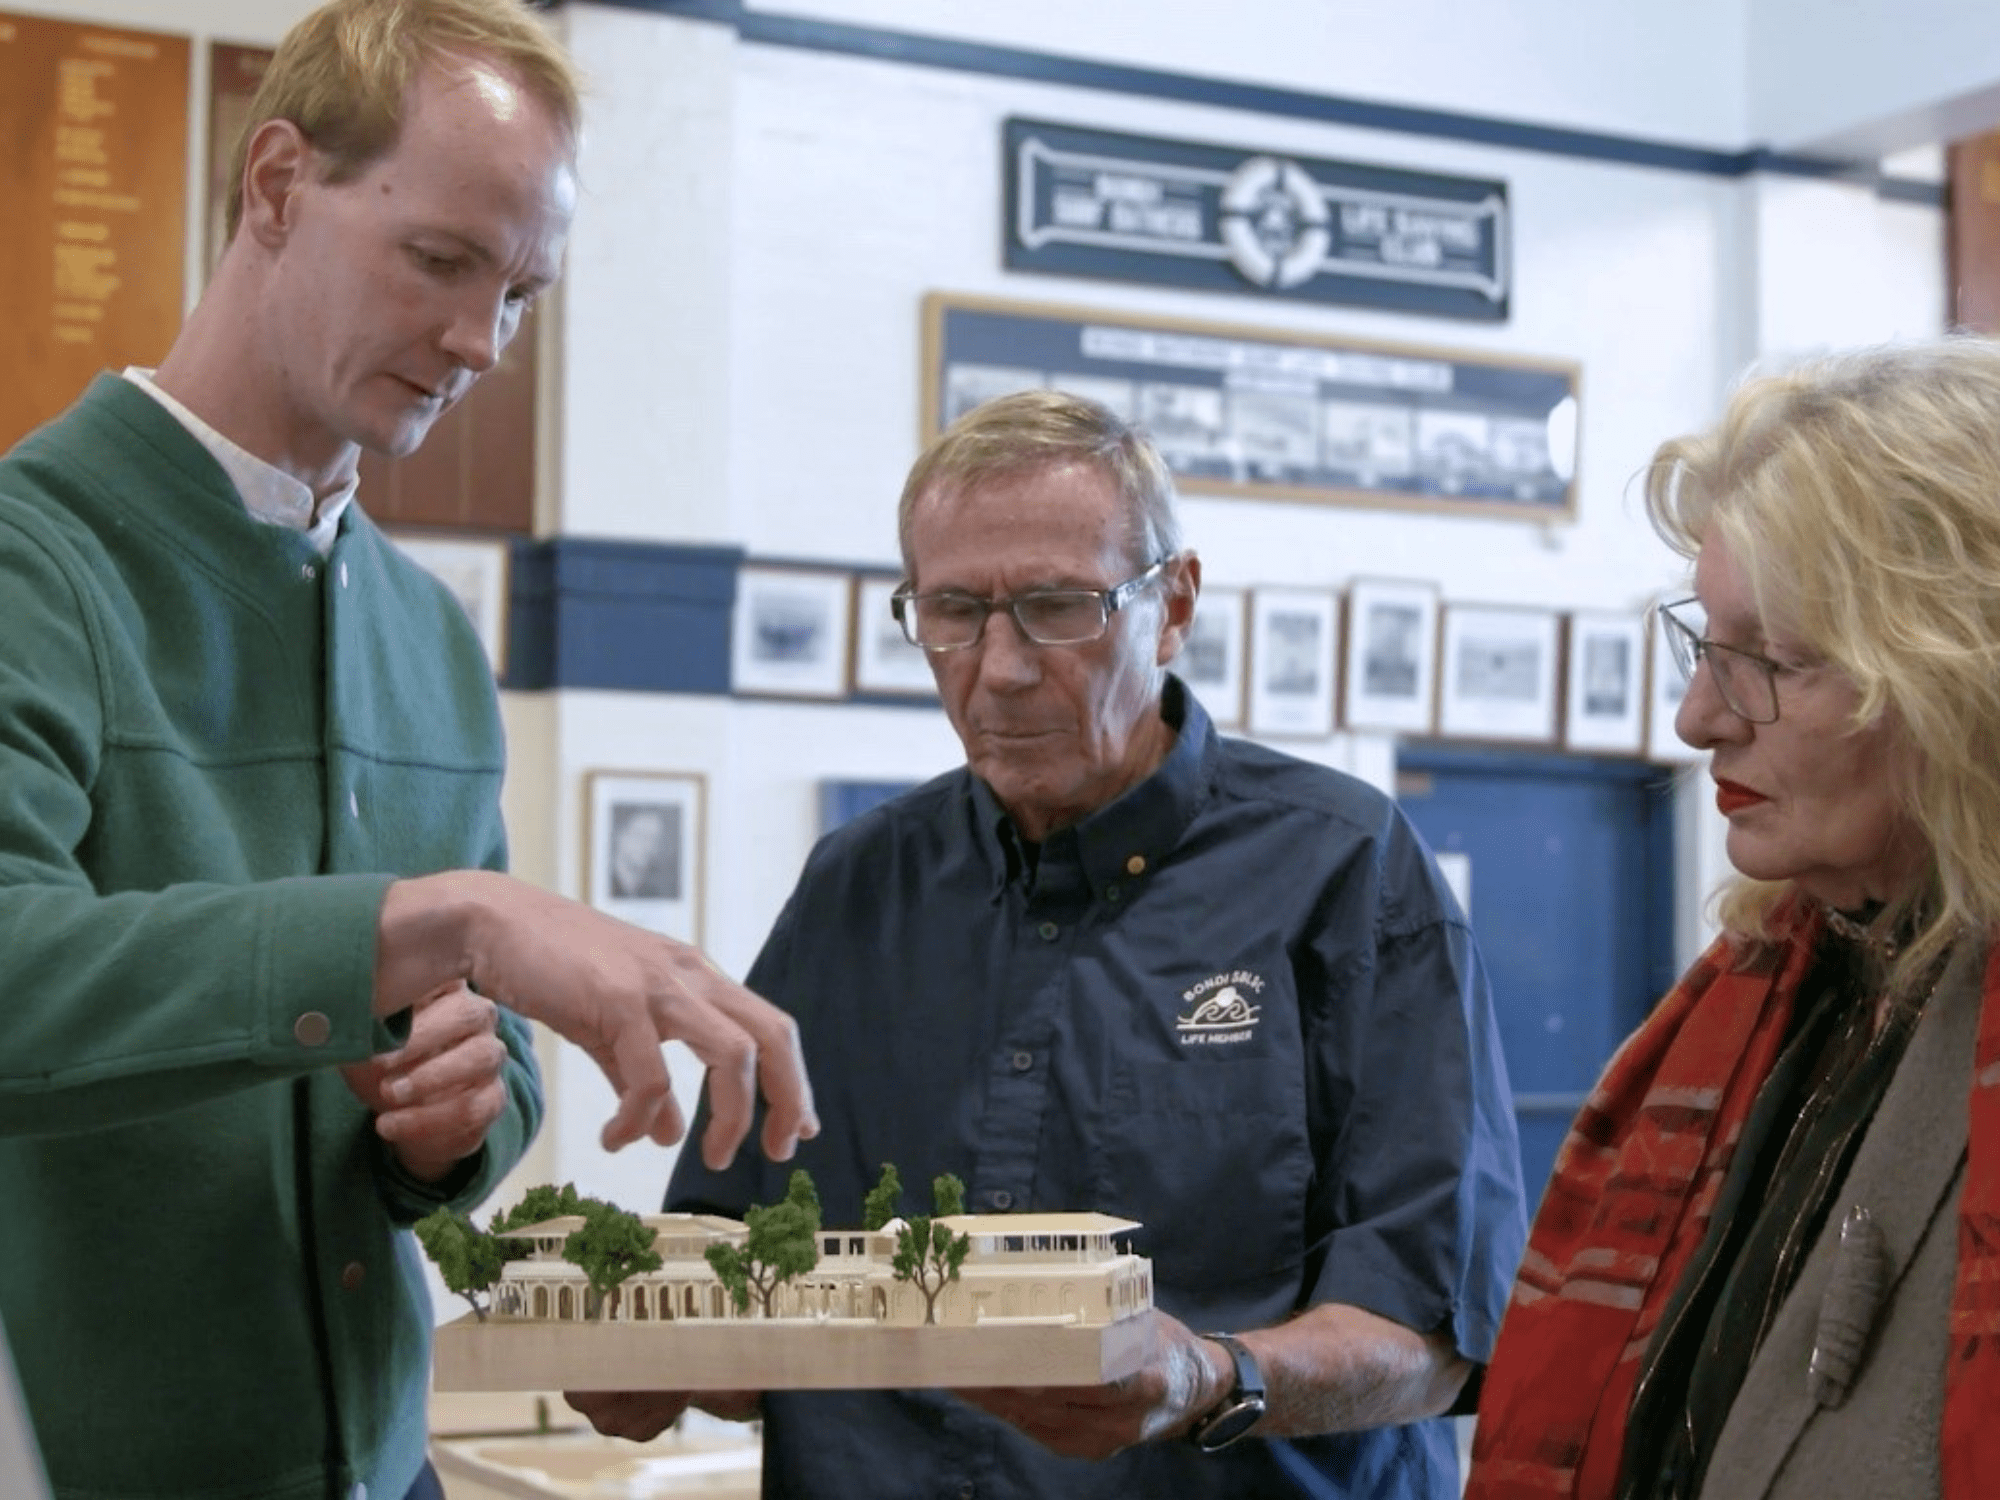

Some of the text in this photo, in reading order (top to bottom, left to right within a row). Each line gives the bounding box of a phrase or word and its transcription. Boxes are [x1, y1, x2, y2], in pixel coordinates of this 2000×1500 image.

[1183, 973, 1229, 1001] BONDI
[1181, 1030, 1252, 1045] LIFE MEMBER
